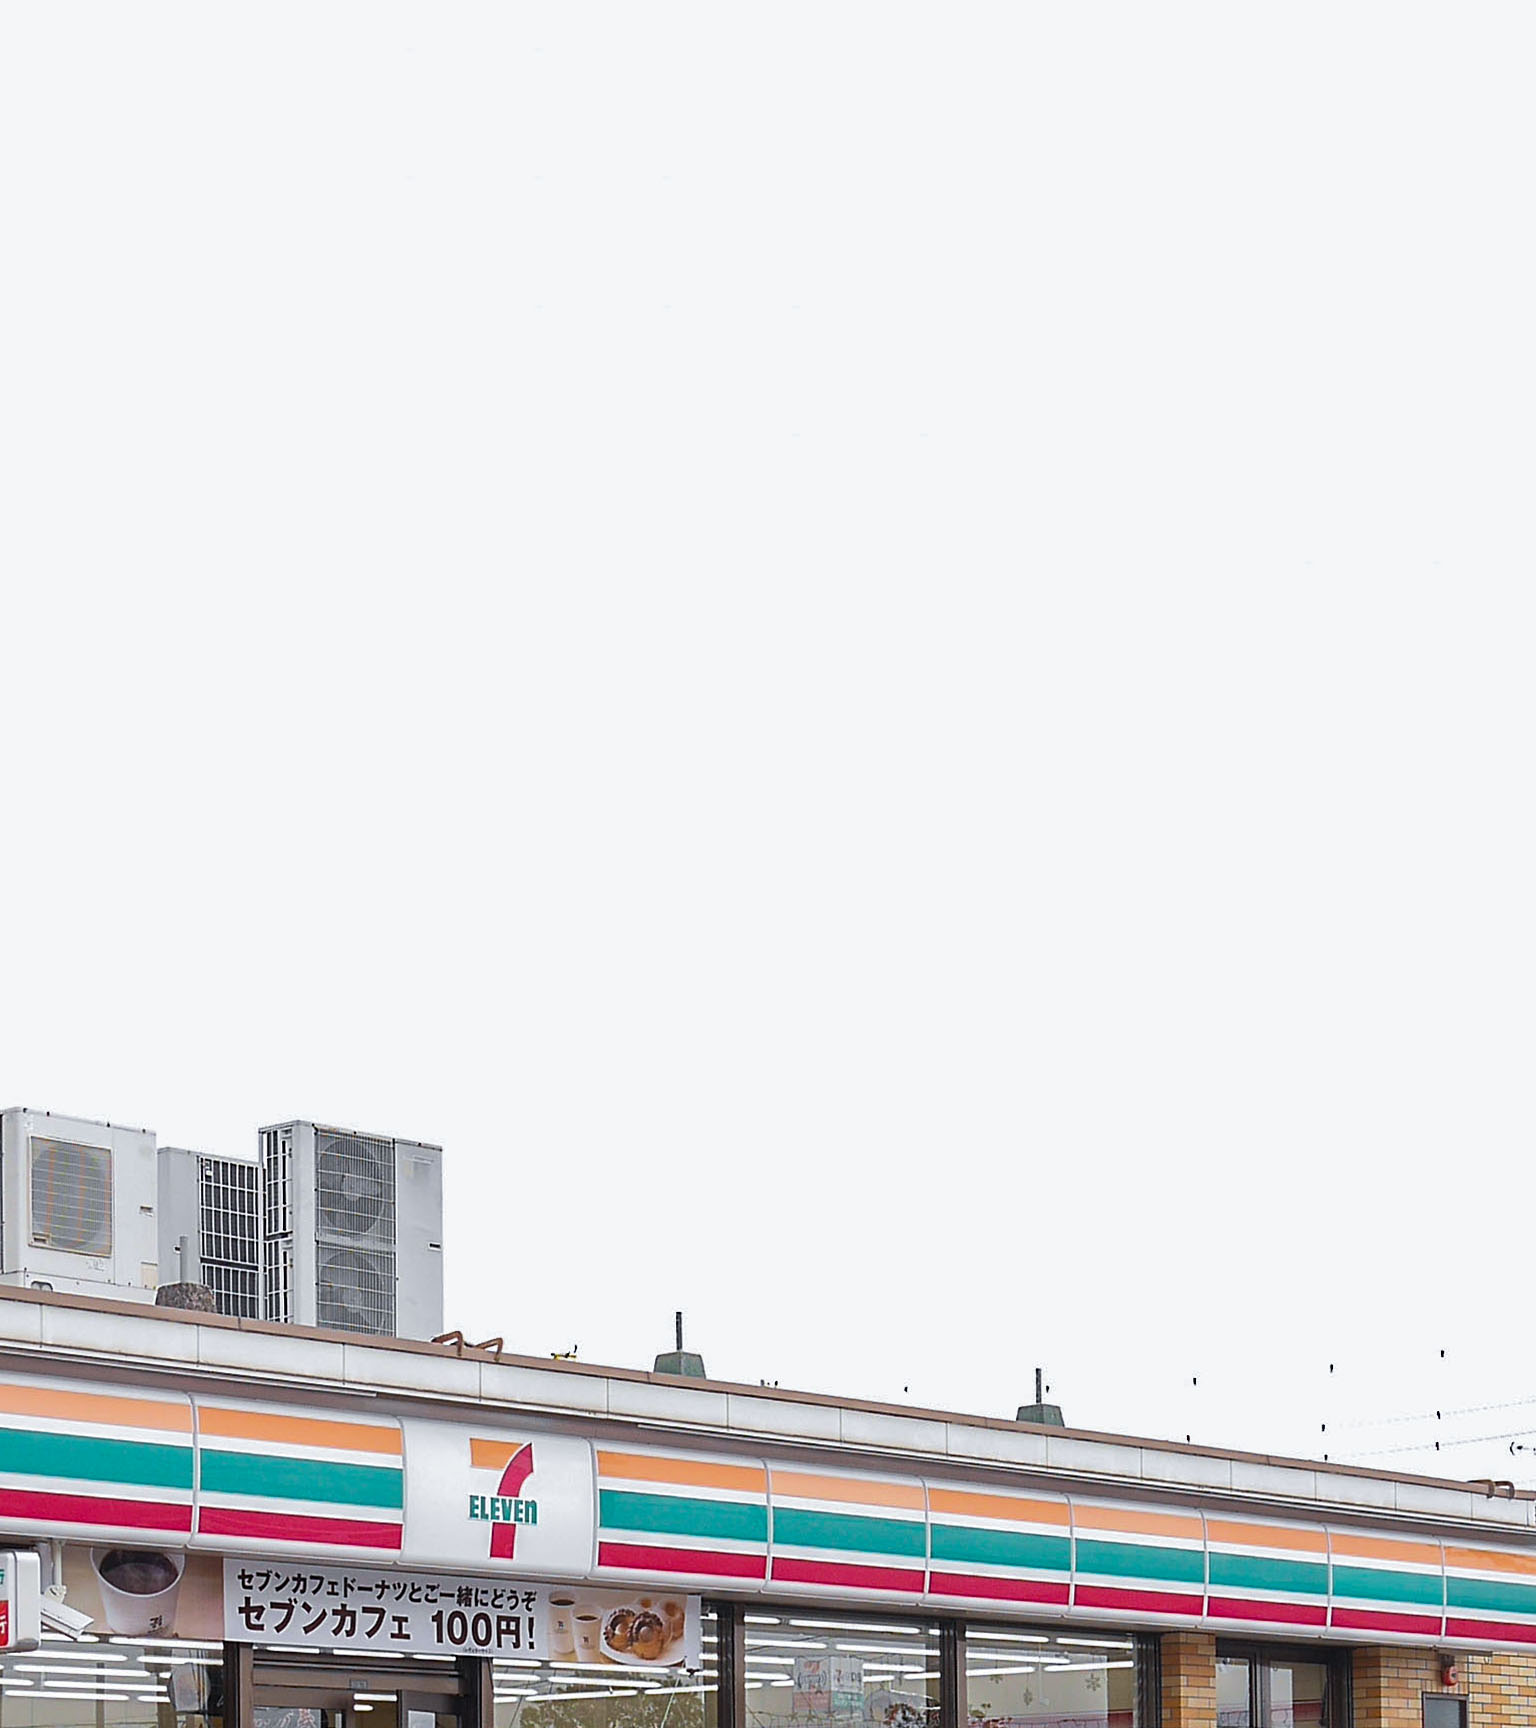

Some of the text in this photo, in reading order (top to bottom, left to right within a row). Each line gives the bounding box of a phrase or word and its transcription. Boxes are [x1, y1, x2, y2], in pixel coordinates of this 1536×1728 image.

[469, 1437, 534, 1559] 7
[237, 1568, 536, 1612] セブンカフェドーナツとご一緒にどうぞ
[238, 1597, 536, 1650] セブンカフェ 100円!
